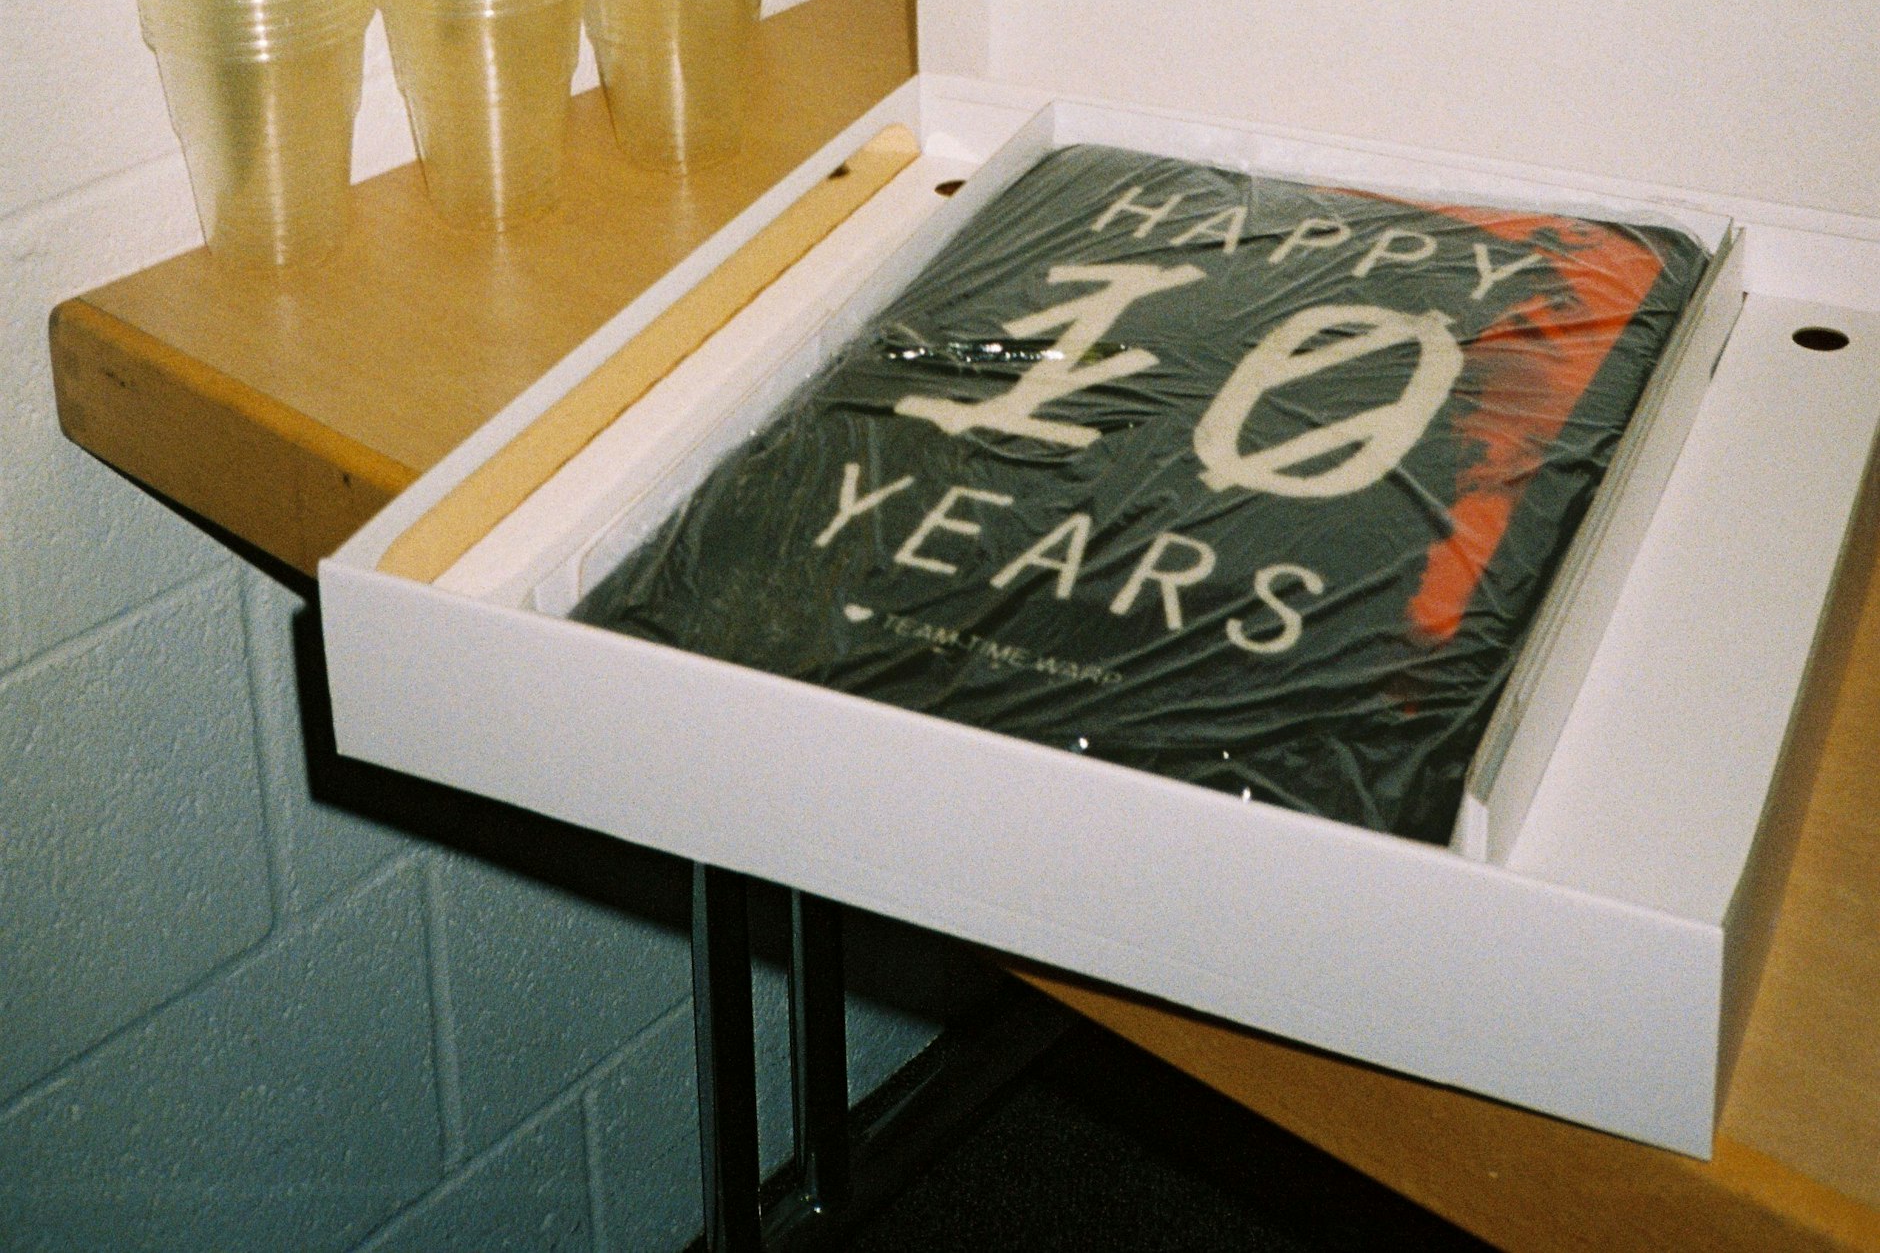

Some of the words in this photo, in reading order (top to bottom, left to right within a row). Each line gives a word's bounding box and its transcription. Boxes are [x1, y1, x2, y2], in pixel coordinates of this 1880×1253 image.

[1091, 186, 1543, 300] HAPPY
[895, 264, 1464, 497] 10
[815, 463, 1324, 653] YEARS
[883, 613, 959, 645] TEAM
